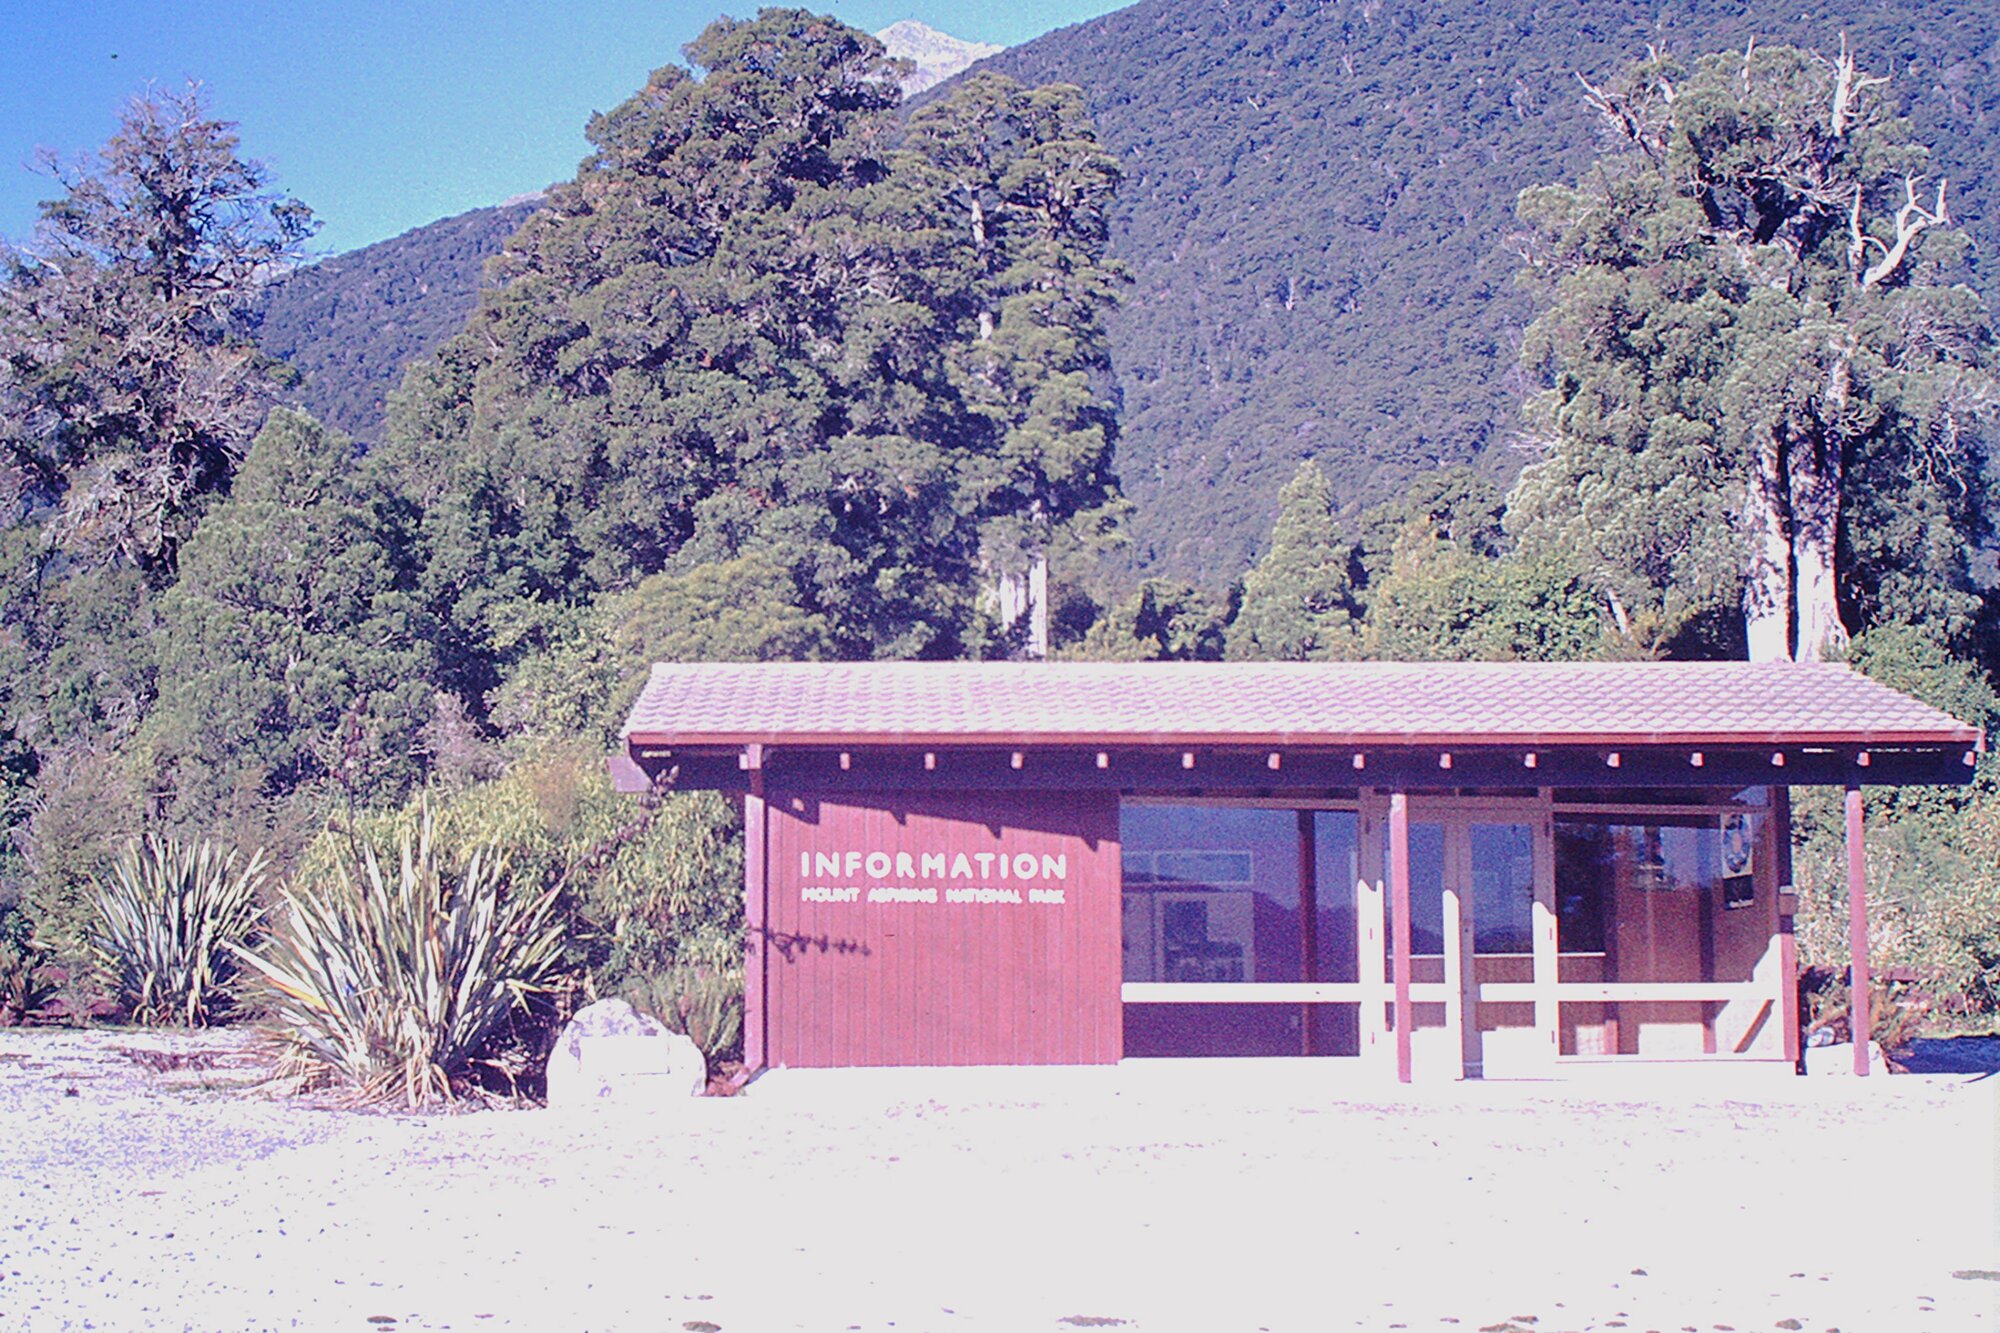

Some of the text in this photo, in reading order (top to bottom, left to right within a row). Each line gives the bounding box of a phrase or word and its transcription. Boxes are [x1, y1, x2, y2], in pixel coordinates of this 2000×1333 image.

[801, 851, 1067, 880] INFORMATION
[801, 887, 861, 903] MOUNT
[945, 887, 1023, 904] NATIONAL
